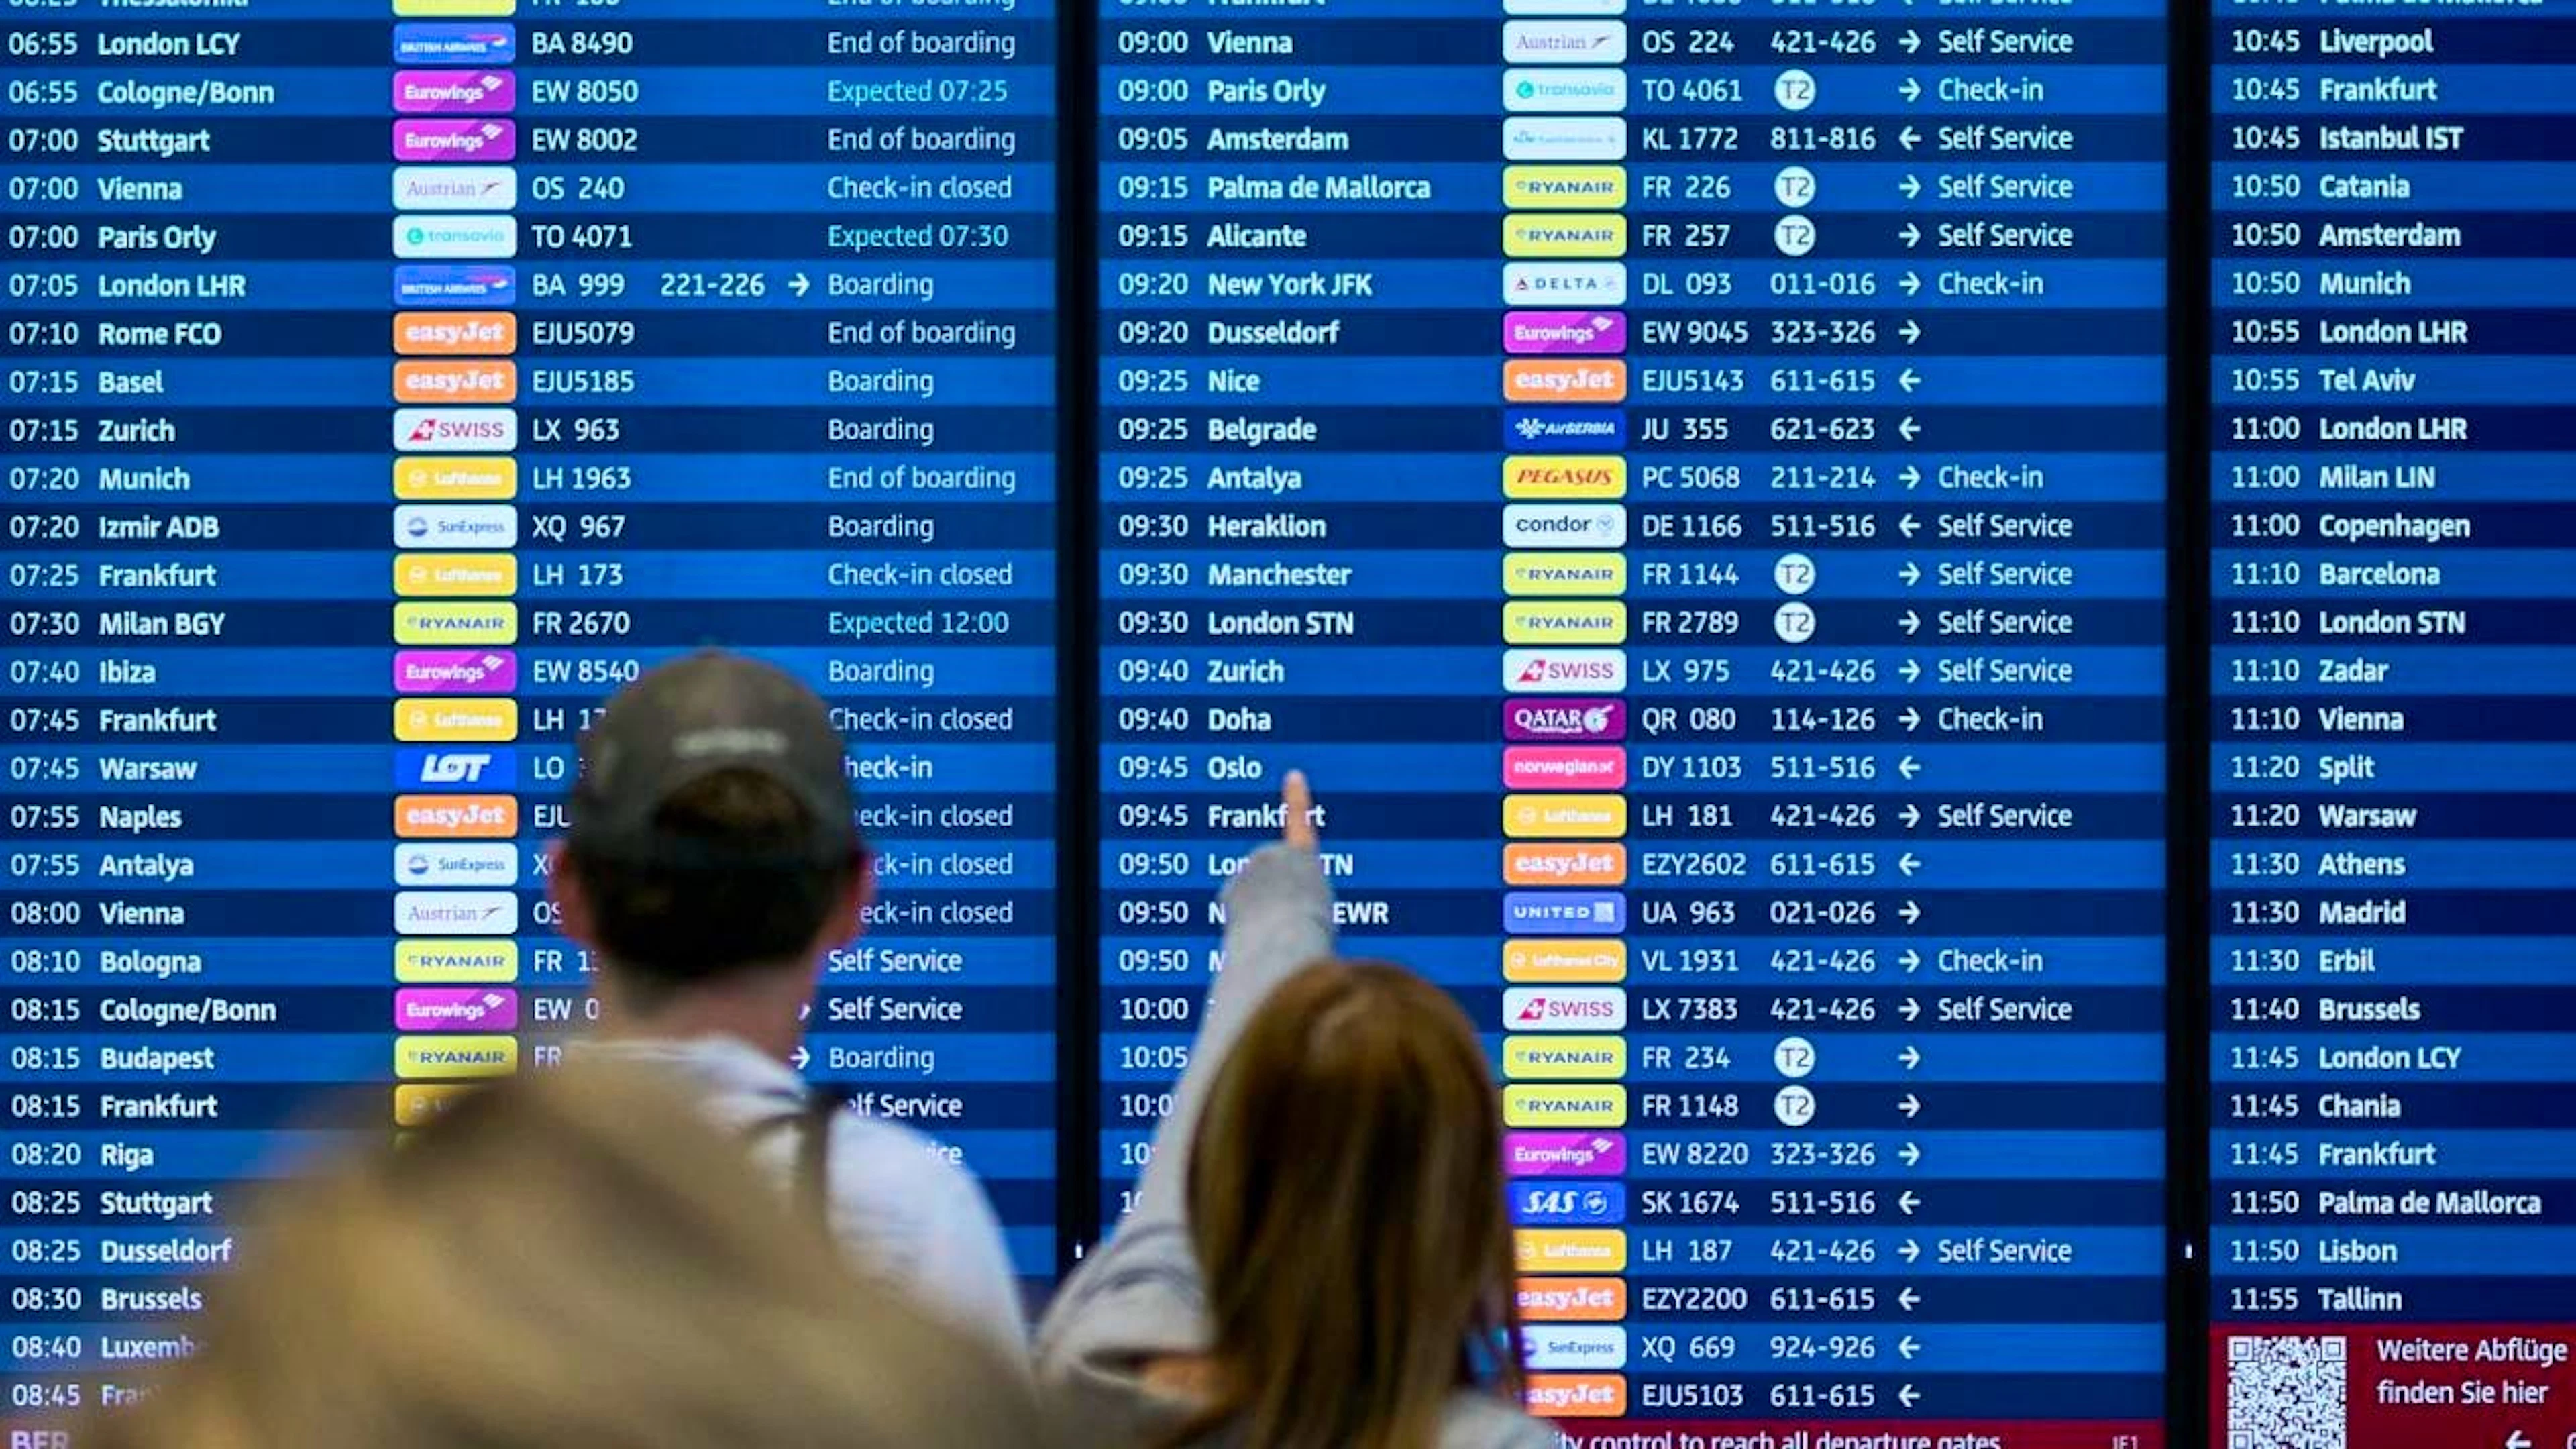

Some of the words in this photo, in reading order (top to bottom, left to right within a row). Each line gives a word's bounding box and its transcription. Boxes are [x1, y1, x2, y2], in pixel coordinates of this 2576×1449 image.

[9, 31, 78, 56] 06:55
[98, 31, 190, 56] London
[196, 32, 241, 56] LCY
[532, 32, 566, 54] BA
[571, 31, 633, 55] 8490
[828, 30, 873, 54] End
[879, 29, 905, 54] of
[912, 30, 1016, 60] boarding
[1118, 79, 1189, 102] 09:00
[1208, 78, 1268, 103] Paris
[1273, 78, 1326, 108] Orly
[1642, 78, 1675, 102] TO
[1682, 79, 1742, 102] 4061
[1781, 79, 1809, 101] T2
[1939, 77, 2043, 102] Check-in
[2233, 77, 2300, 101] 10:45
[2320, 76, 2438, 101] Frankfurt
[9, 176, 79, 200] 07:00
[97, 176, 182, 201] Vienna
[406, 178, 476, 197] Austrian
[532, 176, 565, 200] OS
[578, 176, 625, 199] 240
[828, 175, 932, 199] Check-in
[939, 175, 1012, 199] closed
[2233, 174, 2300, 197] 10:50
[2320, 174, 2410, 199] Catania
[1118, 224, 1188, 247] 09:15
[1206, 223, 1307, 248] Alicante
[1529, 228, 1613, 242] RYANAIR
[1643, 224, 1672, 246] FR
[1685, 223, 1730, 247] 257
[1780, 225, 1809, 246] T2
[1939, 221, 1985, 247] Self
[1990, 222, 2073, 247] Service
[1534, 277, 1597, 290] DELTA
[2233, 271, 2300, 294] 10:50
[2320, 270, 2411, 295] Munich
[9, 321, 79, 345] 07:10
[99, 323, 168, 345] Rome
[174, 322, 222, 345] FCO
[533, 321, 635, 345] EJU5079
[828, 321, 873, 344] End
[880, 319, 905, 343] of
[912, 321, 1016, 350] boarding
[1118, 369, 1188, 392] 09:25
[1208, 368, 1260, 392] Nice
[1643, 369, 1744, 392] EJU5143
[1771, 369, 1875, 392] 611-615
[2233, 368, 2300, 391] 10:55
[2318, 367, 2357, 392] Tel
[2361, 367, 2416, 392] Aviv
[10, 467, 80, 490] 07:20
[99, 466, 191, 490] Munich
[533, 467, 563, 490] LH
[573, 466, 631, 490] 1963
[829, 466, 873, 488] End
[880, 464, 905, 488] of
[912, 466, 1016, 494] boarding
[1517, 469, 1611, 486] PEGASUS
[2233, 465, 2300, 488] 11:00
[2320, 464, 2388, 488] Milan
[2396, 466, 2435, 488] LIN
[1119, 514, 1189, 537] 09:30
[1208, 513, 1326, 537] Heraklion
[1515, 515, 1592, 532] condor
[1643, 514, 1674, 537] DE
[1682, 514, 1742, 537] 1166
[1772, 514, 1876, 537] 511-516
[1939, 512, 1984, 537] Self
[1990, 513, 2072, 537] Service
[2232, 561, 2300, 585] 11:10
[2320, 561, 2440, 585] Barcelona
[11, 611, 80, 635] 07:30
[99, 610, 168, 635] Milan
[175, 612, 225, 635] BGY
[419, 616, 506, 631] RYANAIR
[533, 611, 562, 634] FR
[569, 610, 631, 635] 2670
[829, 610, 933, 639] Expected
[942, 611, 1010, 633] 12:00
[1119, 659, 1189, 682] 09:40
[1208, 659, 1284, 683] Zurich
[1548, 662, 1614, 679] SWISS
[1643, 659, 1671, 682] LX
[1684, 659, 1730, 682] 975
[1771, 659, 1875, 682] 421-426
[1939, 657, 1984, 682] Self
[1990, 658, 2072, 682] Service
[2233, 659, 2300, 682] 11:10
[2319, 657, 2390, 682] Zadar
[11, 756, 80, 780] 07:45
[99, 757, 197, 780] Warsaw
[420, 753, 492, 783] LOT
[2232, 755, 2300, 778] 11:20
[2319, 754, 2375, 785] Split
[1119, 804, 1188, 827] 09:45
[1208, 803, 1326, 829] Frankfrt
[1643, 804, 1672, 826] LH
[1688, 804, 1733, 826] 181
[1770, 804, 1875, 827] 421-426
[1939, 802, 1984, 828] Self
[1990, 802, 2072, 828] Service
[2232, 852, 2300, 875] 11:30
[2318, 852, 2406, 875] Athens
[11, 901, 80, 924] 08:00
[99, 900, 184, 925] Vienna
[407, 906, 478, 922] Austrian
[1333, 900, 1389, 925] EWR
[1514, 906, 1593, 920] UNITED
[1120, 949, 1189, 971] 09:50
[1641, 950, 1672, 971] VL
[1680, 949, 1739, 972] 1931
[1770, 949, 1875, 973] 421-426
[1939, 948, 2043, 973] Check-in
[2231, 949, 2300, 971] 11:30
[2319, 948, 2375, 972] Erbil
[11, 1046, 80, 1069] 08:15
[101, 1046, 215, 1075] Budapest
[830, 1045, 934, 1075] Boarding
[2232, 1046, 2299, 1069] 11:45
[2319, 1045, 2410, 1069] London
[2418, 1046, 2461, 1069] LCY
[1529, 1099, 1613, 1112] RYANAIR
[1643, 1094, 1671, 1116] FR
[1679, 1093, 1739, 1117] 1148
[2231, 1142, 2298, 1165] 11:45
[2319, 1140, 2436, 1166] Frankfurt
[12, 1190, 80, 1214] 08:25
[101, 1191, 213, 1220] Stuttgart
[1522, 1189, 1579, 1214] SAS
[2231, 1239, 2300, 1262] 11:50
[2319, 1238, 2398, 1263] Lisbon
[13, 1336, 82, 1358] 08:40
[2377, 1338, 2469, 1362] Weitere
[2474, 1336, 2568, 1368] Abflüge
[1643, 1383, 1743, 1407] EJU5103
[1770, 1383, 1875, 1407] 611-615
[2376, 1379, 2455, 1404] finden
[2461, 1379, 2496, 1404] Sie
[2502, 1379, 2549, 1404] hier
[1590, 1430, 1672, 1449] control
[1680, 1433, 1705, 1449] to
[1711, 1430, 1774, 1449] reach
[1782, 1430, 1809, 1449] all
